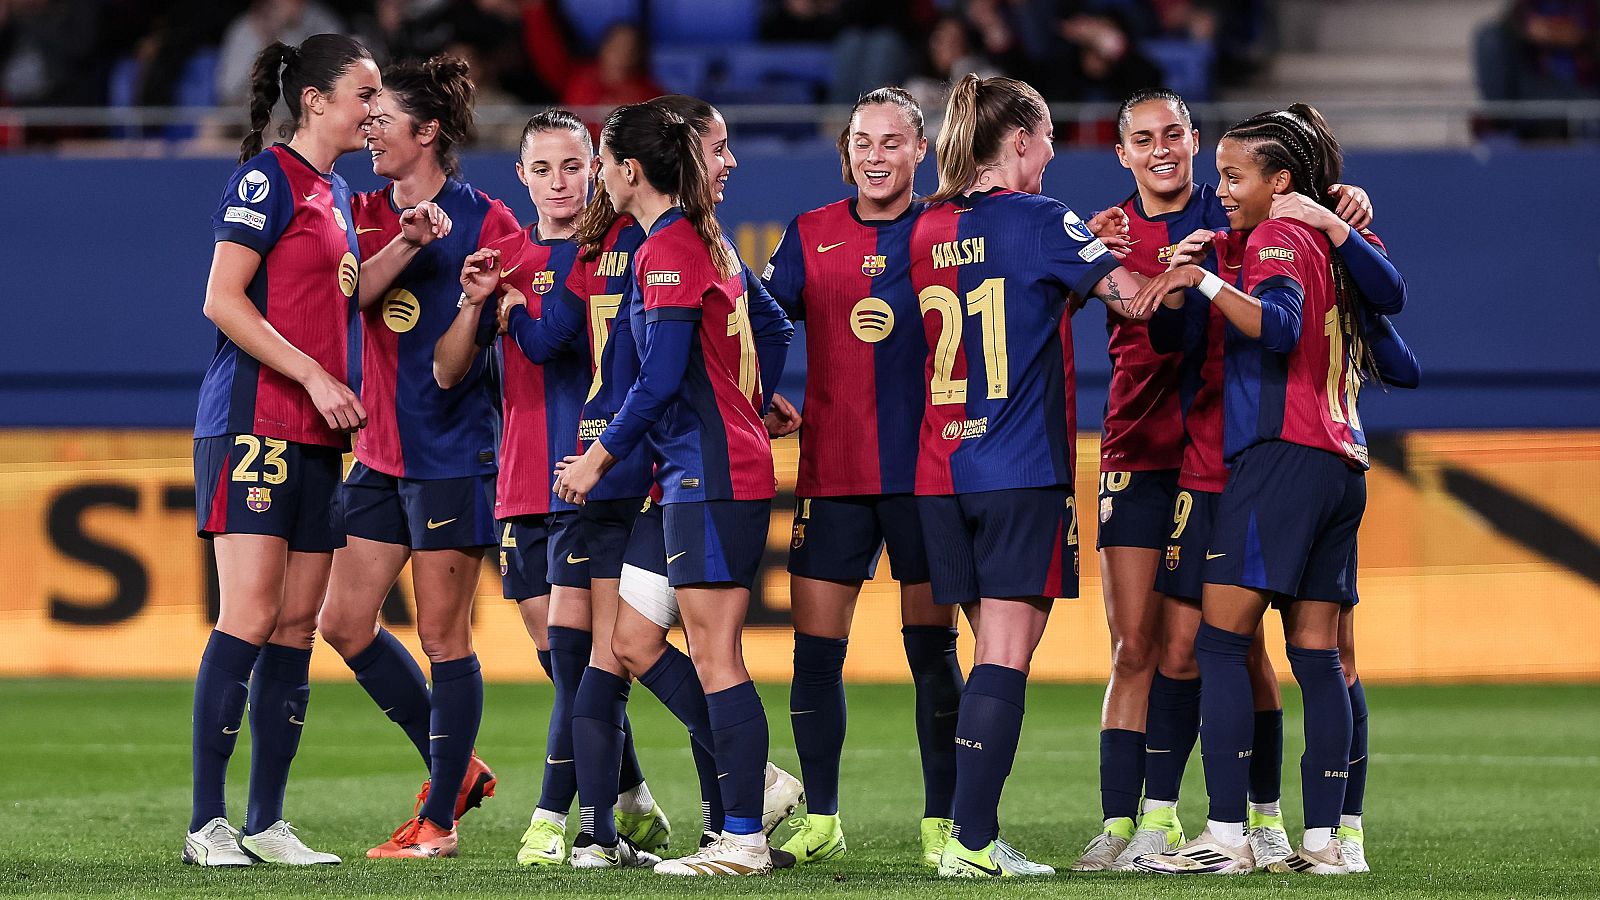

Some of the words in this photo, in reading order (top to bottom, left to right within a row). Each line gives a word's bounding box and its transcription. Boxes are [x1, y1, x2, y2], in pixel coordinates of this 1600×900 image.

[593, 251, 629, 277] ANA
[931, 236, 985, 270] WALSH
[1259, 248, 1294, 261] BIMBO
[646, 273, 681, 285] BIMBO
[918, 277, 1009, 406] 21
[232, 434, 288, 485] 23
[1170, 491, 1193, 539] 9
